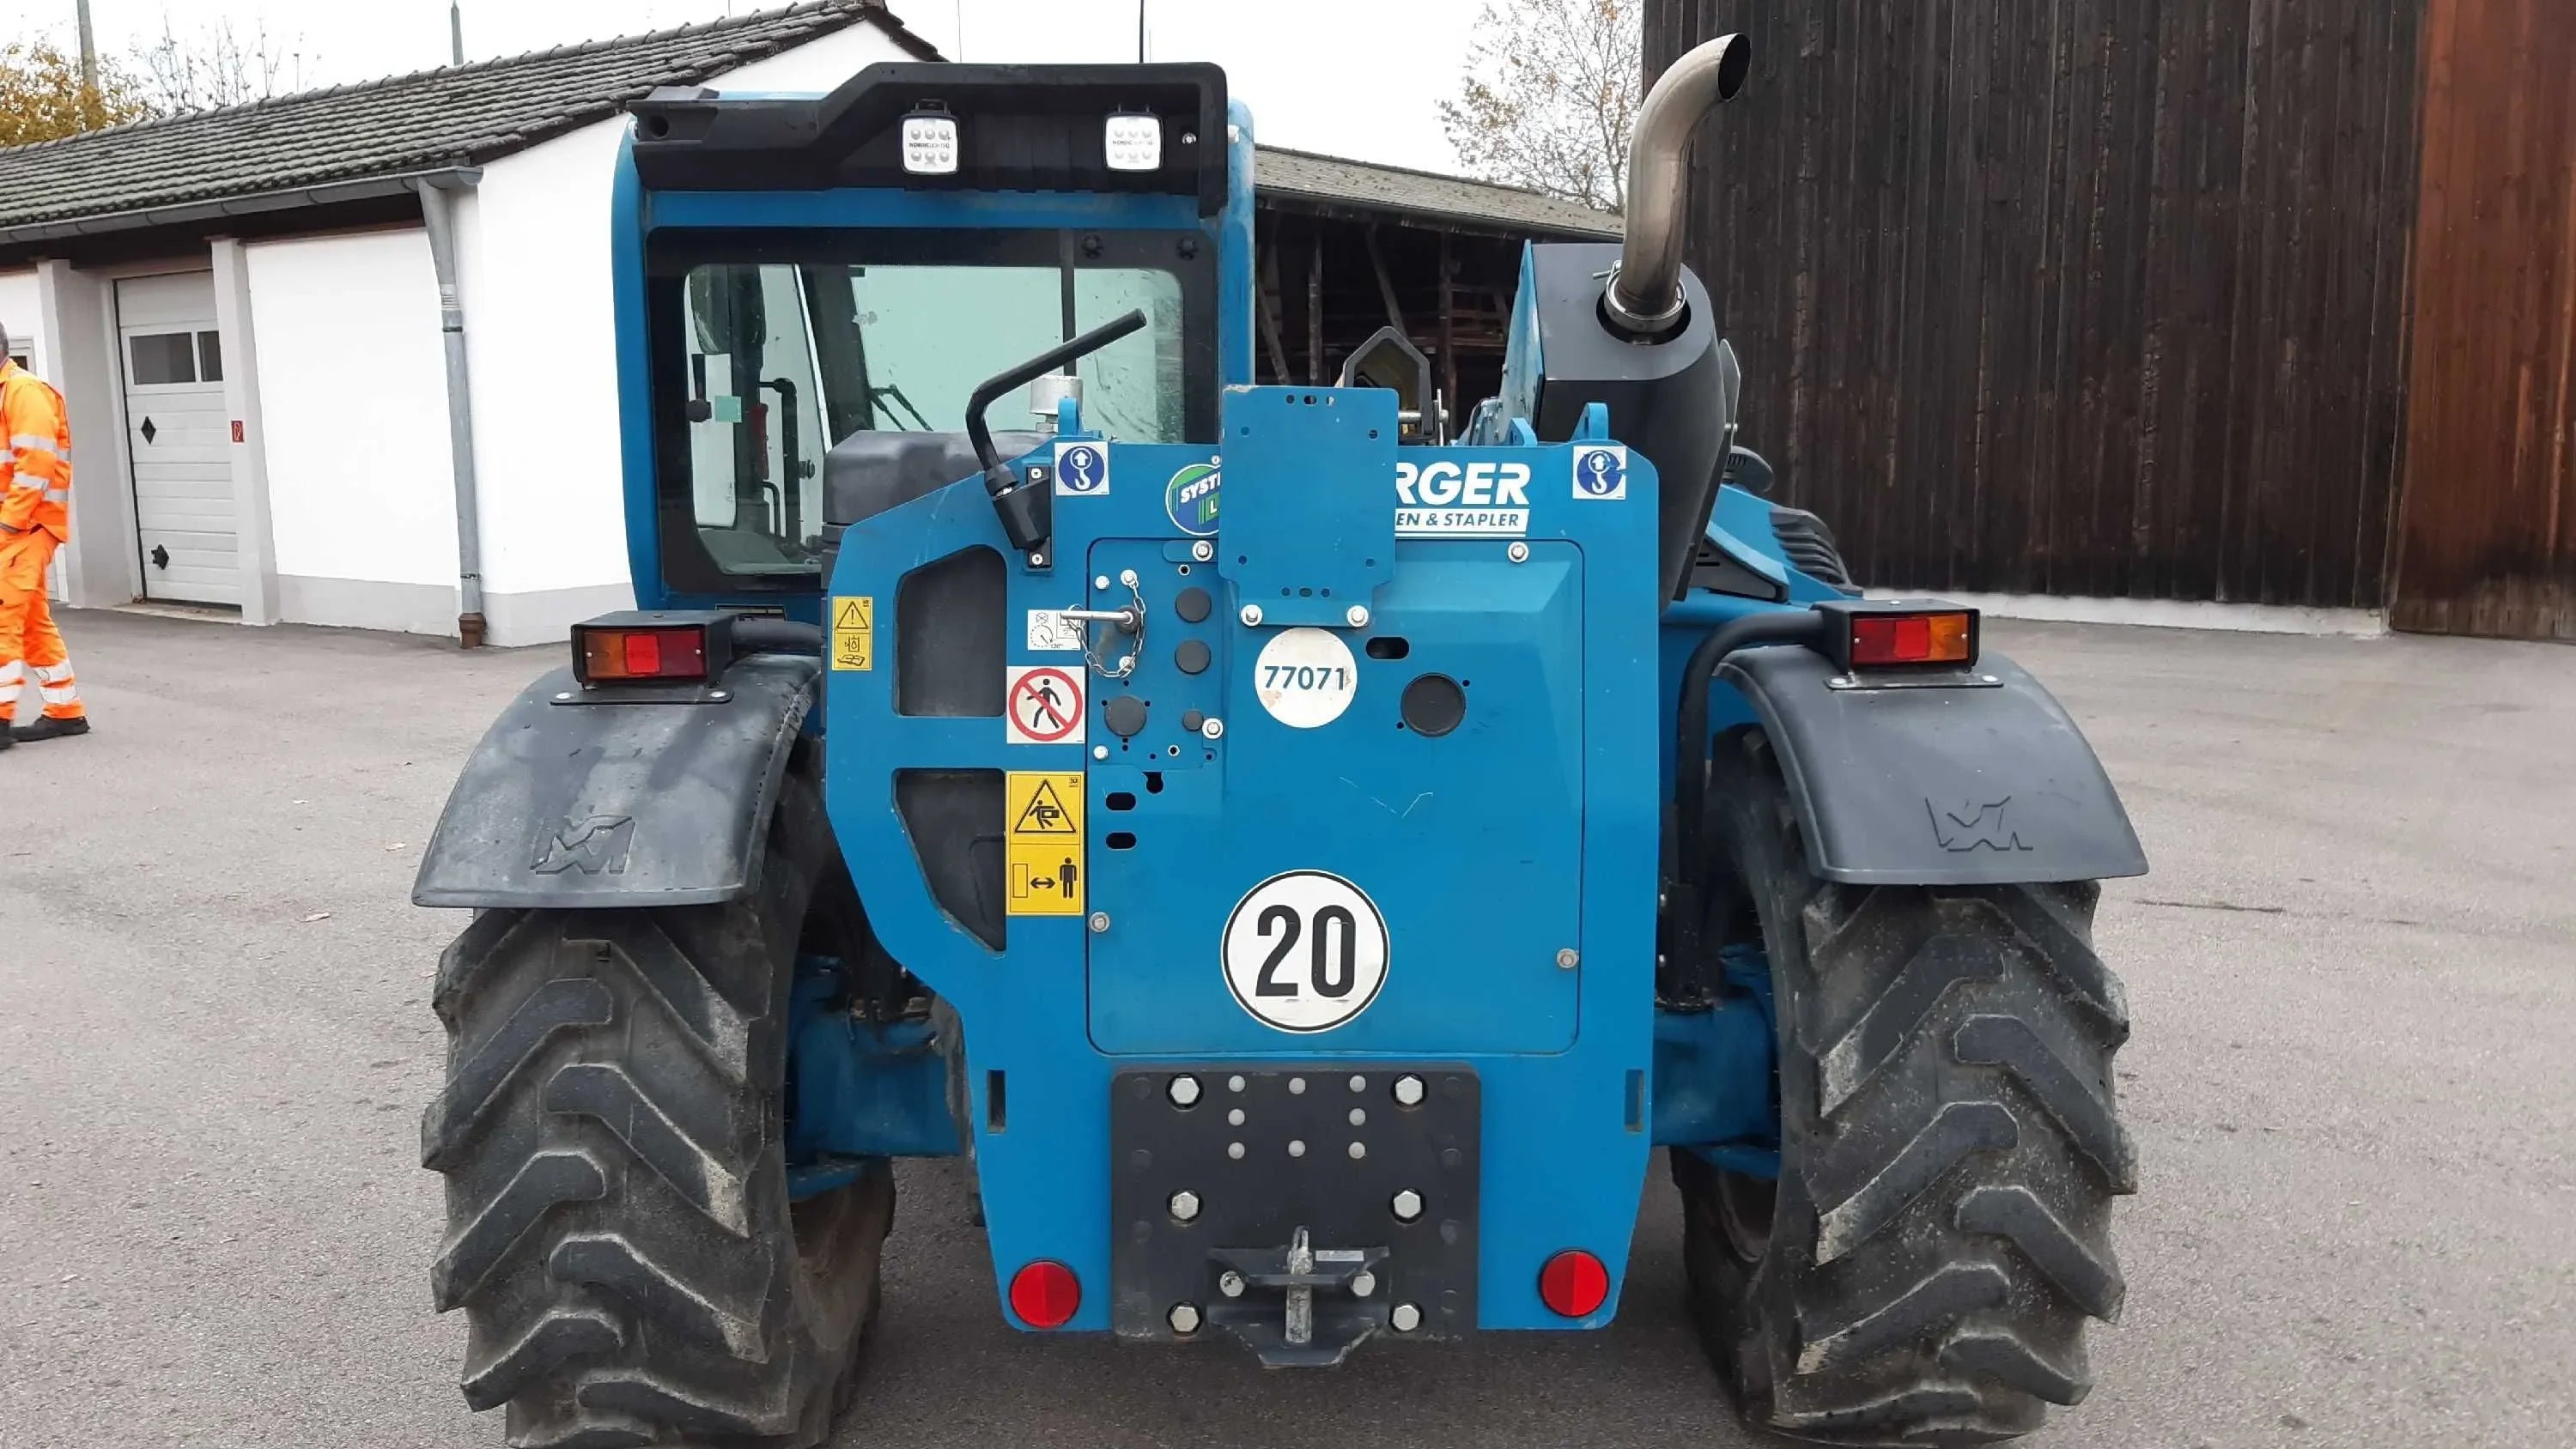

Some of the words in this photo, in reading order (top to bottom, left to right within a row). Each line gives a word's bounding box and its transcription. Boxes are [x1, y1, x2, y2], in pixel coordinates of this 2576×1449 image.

[1395, 461, 1531, 505] RGER
[1395, 512, 1420, 526] EN
[1425, 512, 1438, 526] &
[1443, 512, 1520, 526] STAPLER
[1264, 665, 1345, 691] 77071
[1255, 904, 1357, 998] 20
